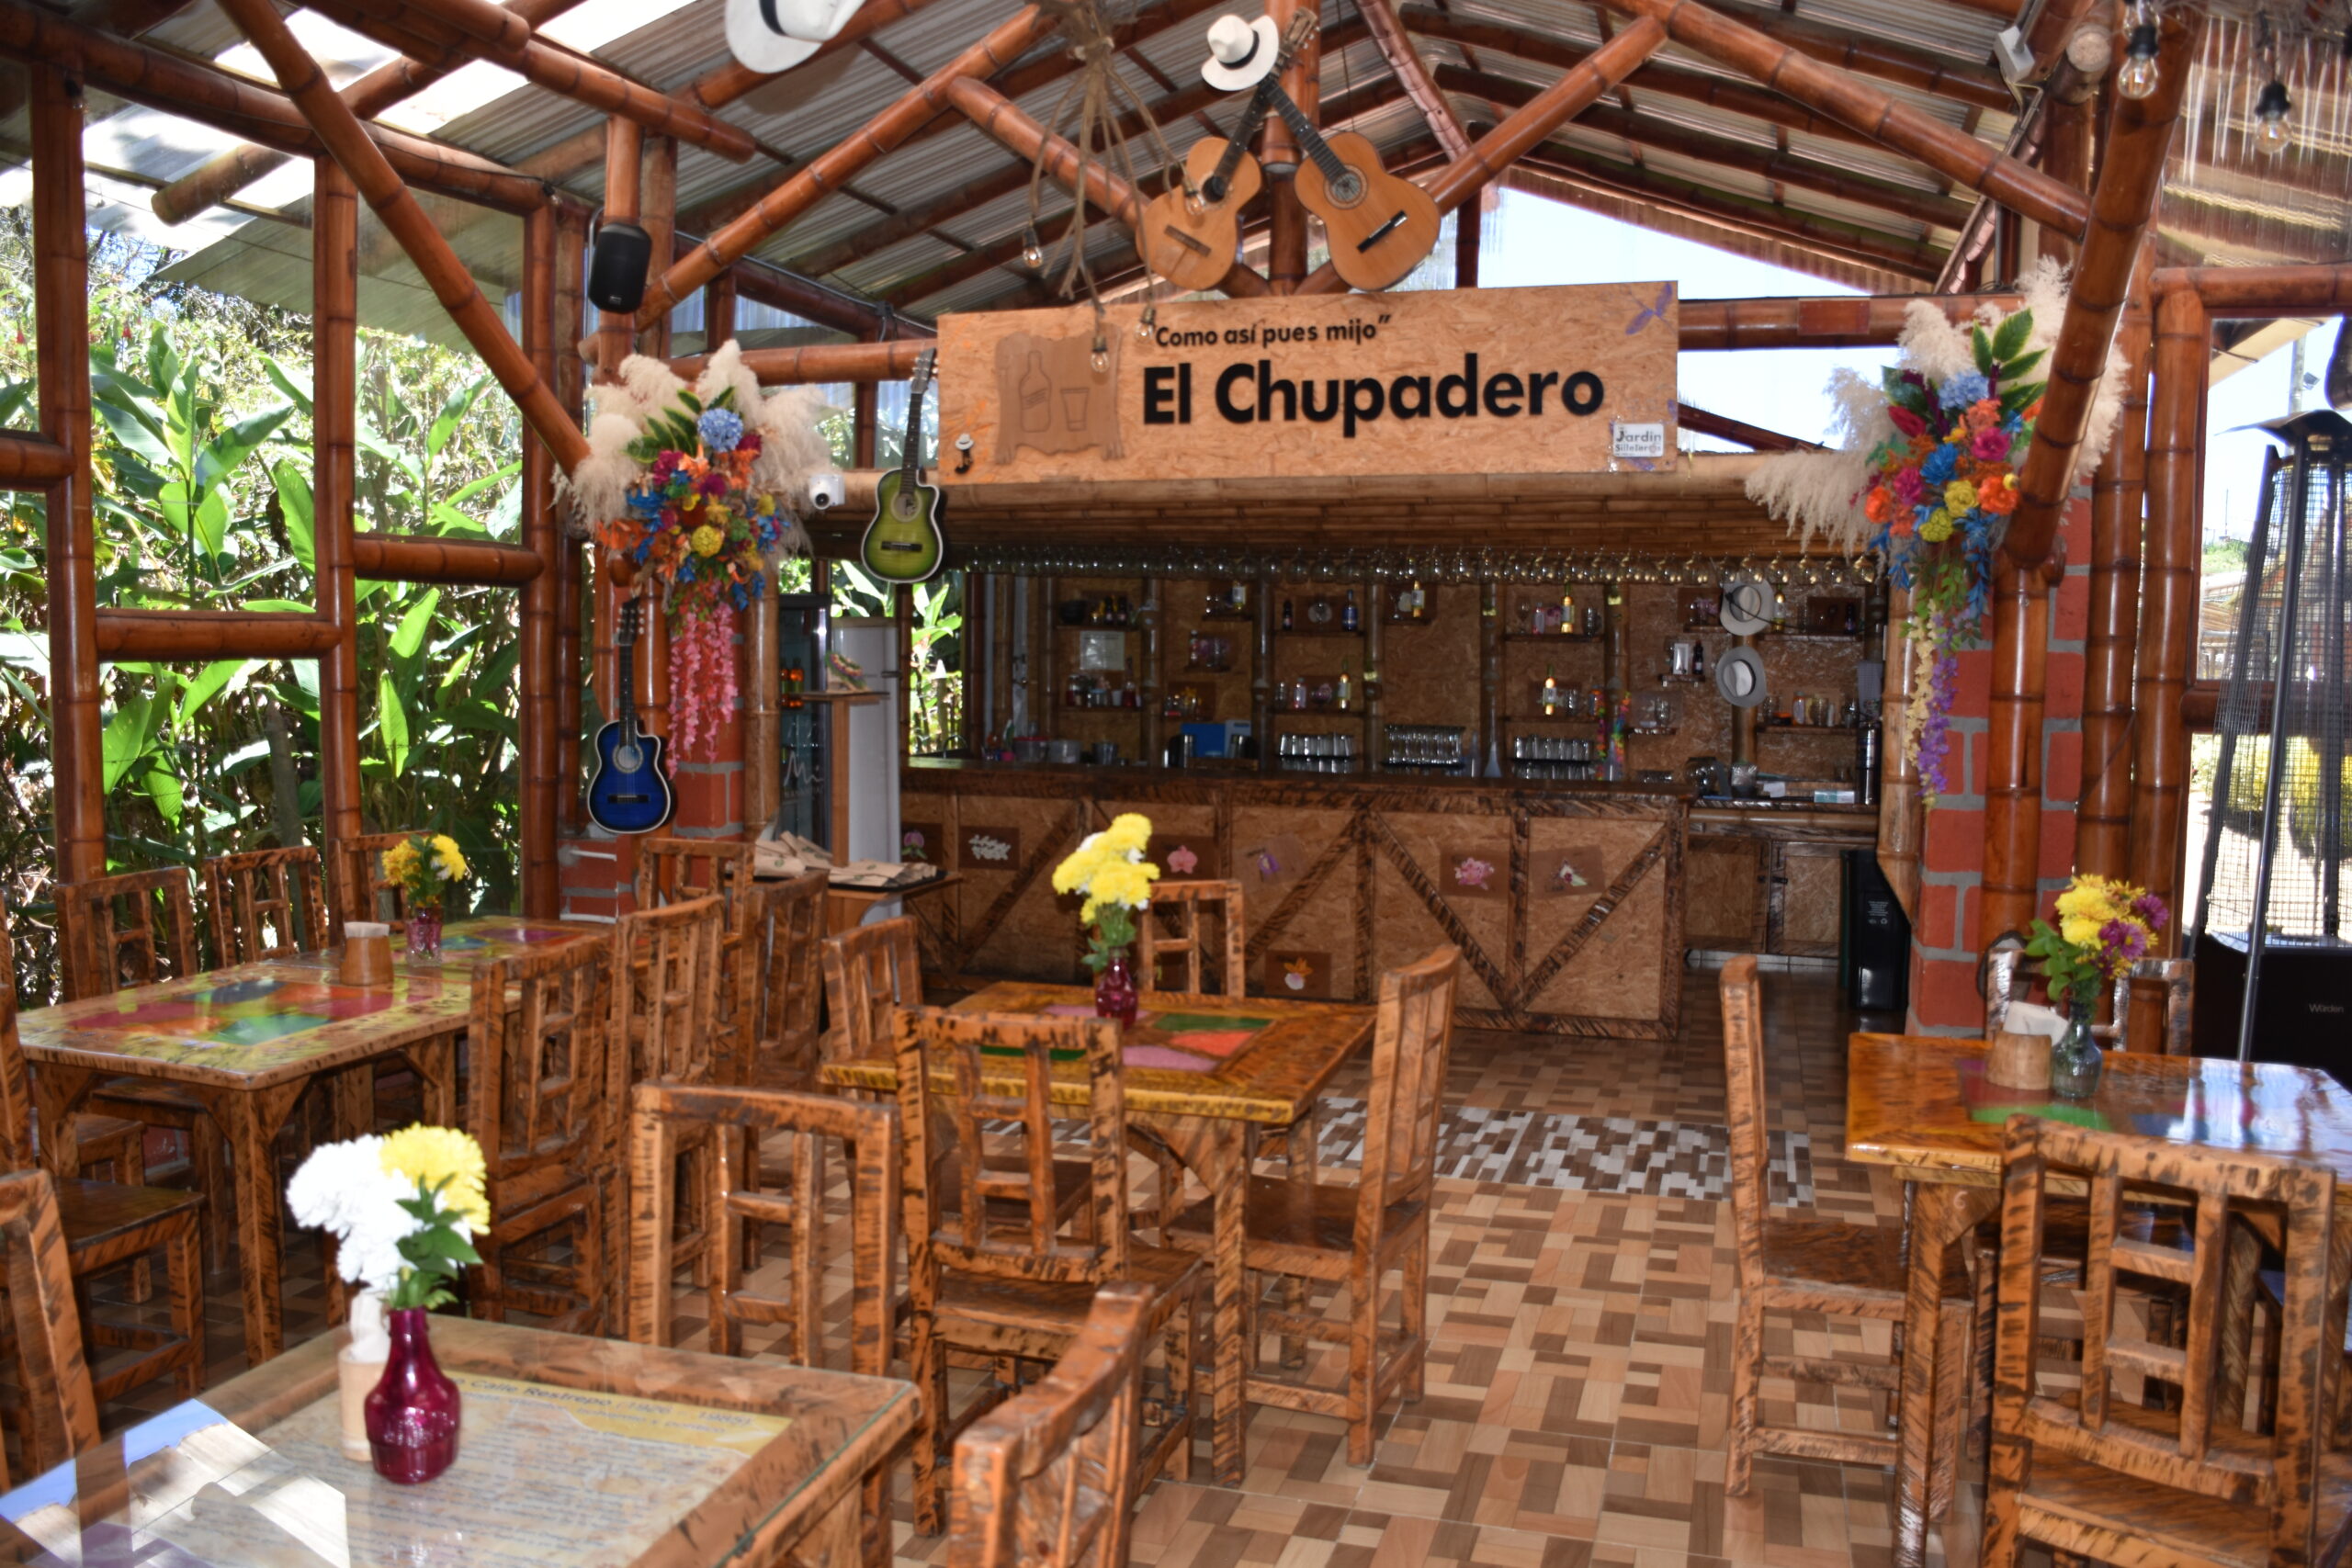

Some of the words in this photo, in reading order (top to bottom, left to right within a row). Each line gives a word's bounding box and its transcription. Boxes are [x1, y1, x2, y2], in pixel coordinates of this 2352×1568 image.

[1224, 322, 1258, 344] así
[1262, 325, 1318, 349] pues
[1144, 362, 1192, 424] El
[1215, 352, 1605, 438] Chupadero
[470, 1379, 518, 1393] Calle
[523, 1386, 613, 1407] Restrepo
